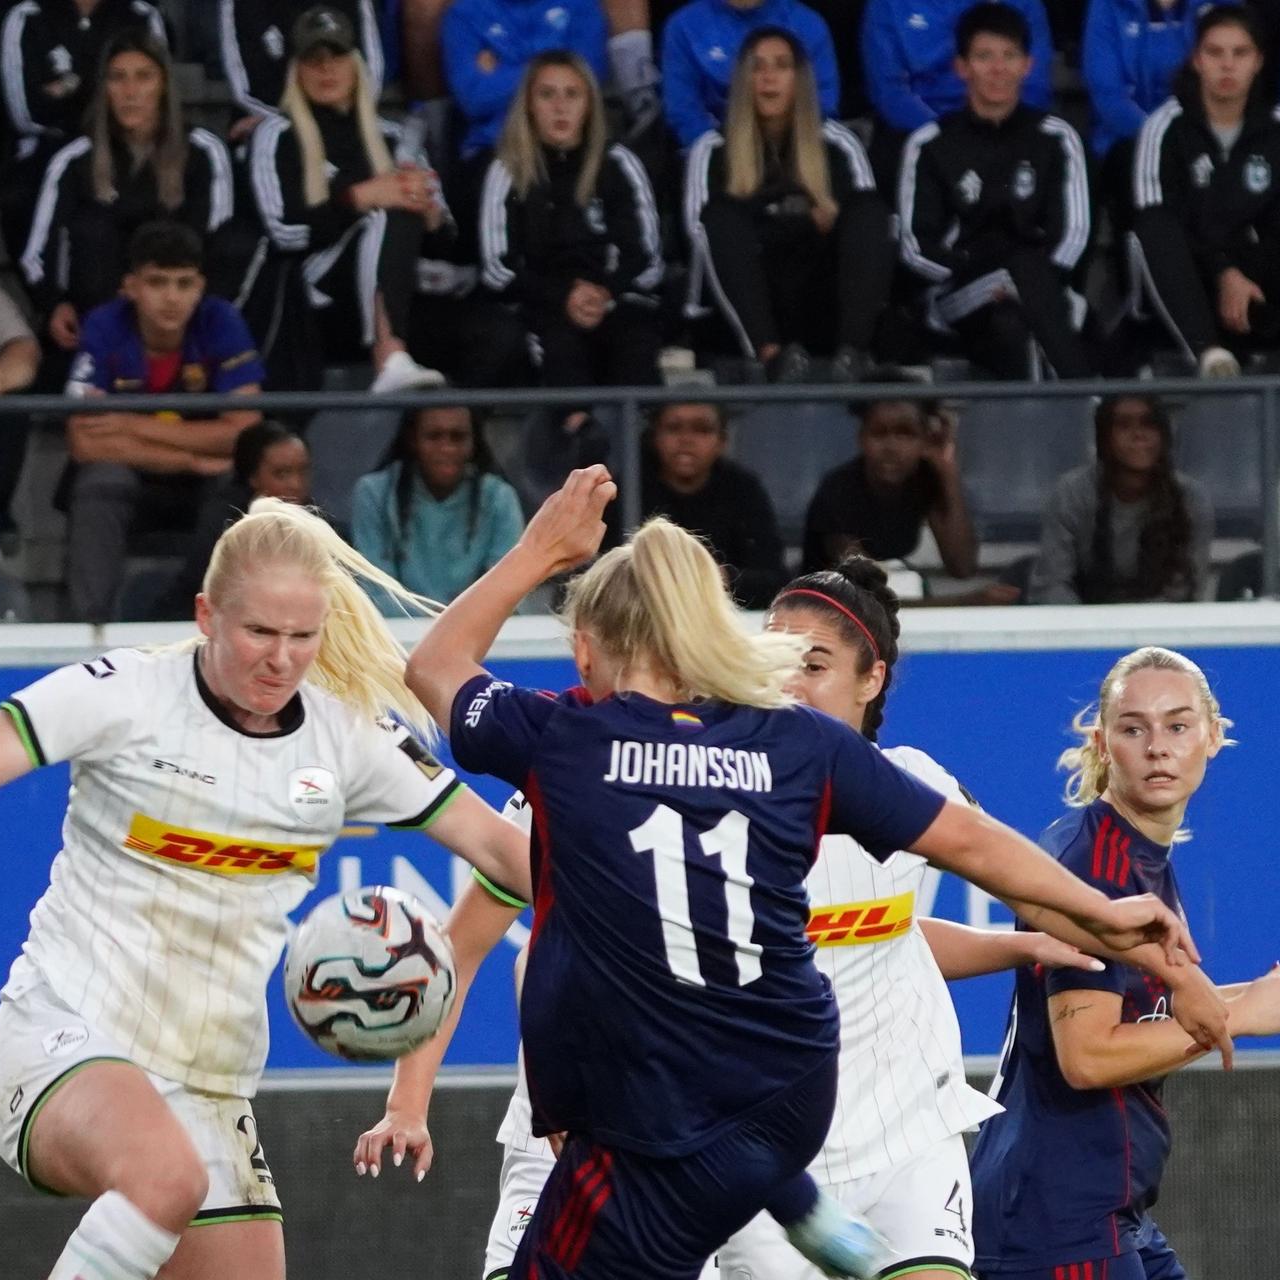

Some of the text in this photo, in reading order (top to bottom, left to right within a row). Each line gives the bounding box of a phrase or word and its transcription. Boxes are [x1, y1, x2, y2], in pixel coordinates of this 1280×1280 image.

[603, 740, 773, 793] JOHANSSON
[628, 803, 764, 987] 11
[805, 904, 897, 943] HL
[944, 1179, 967, 1234] 4
